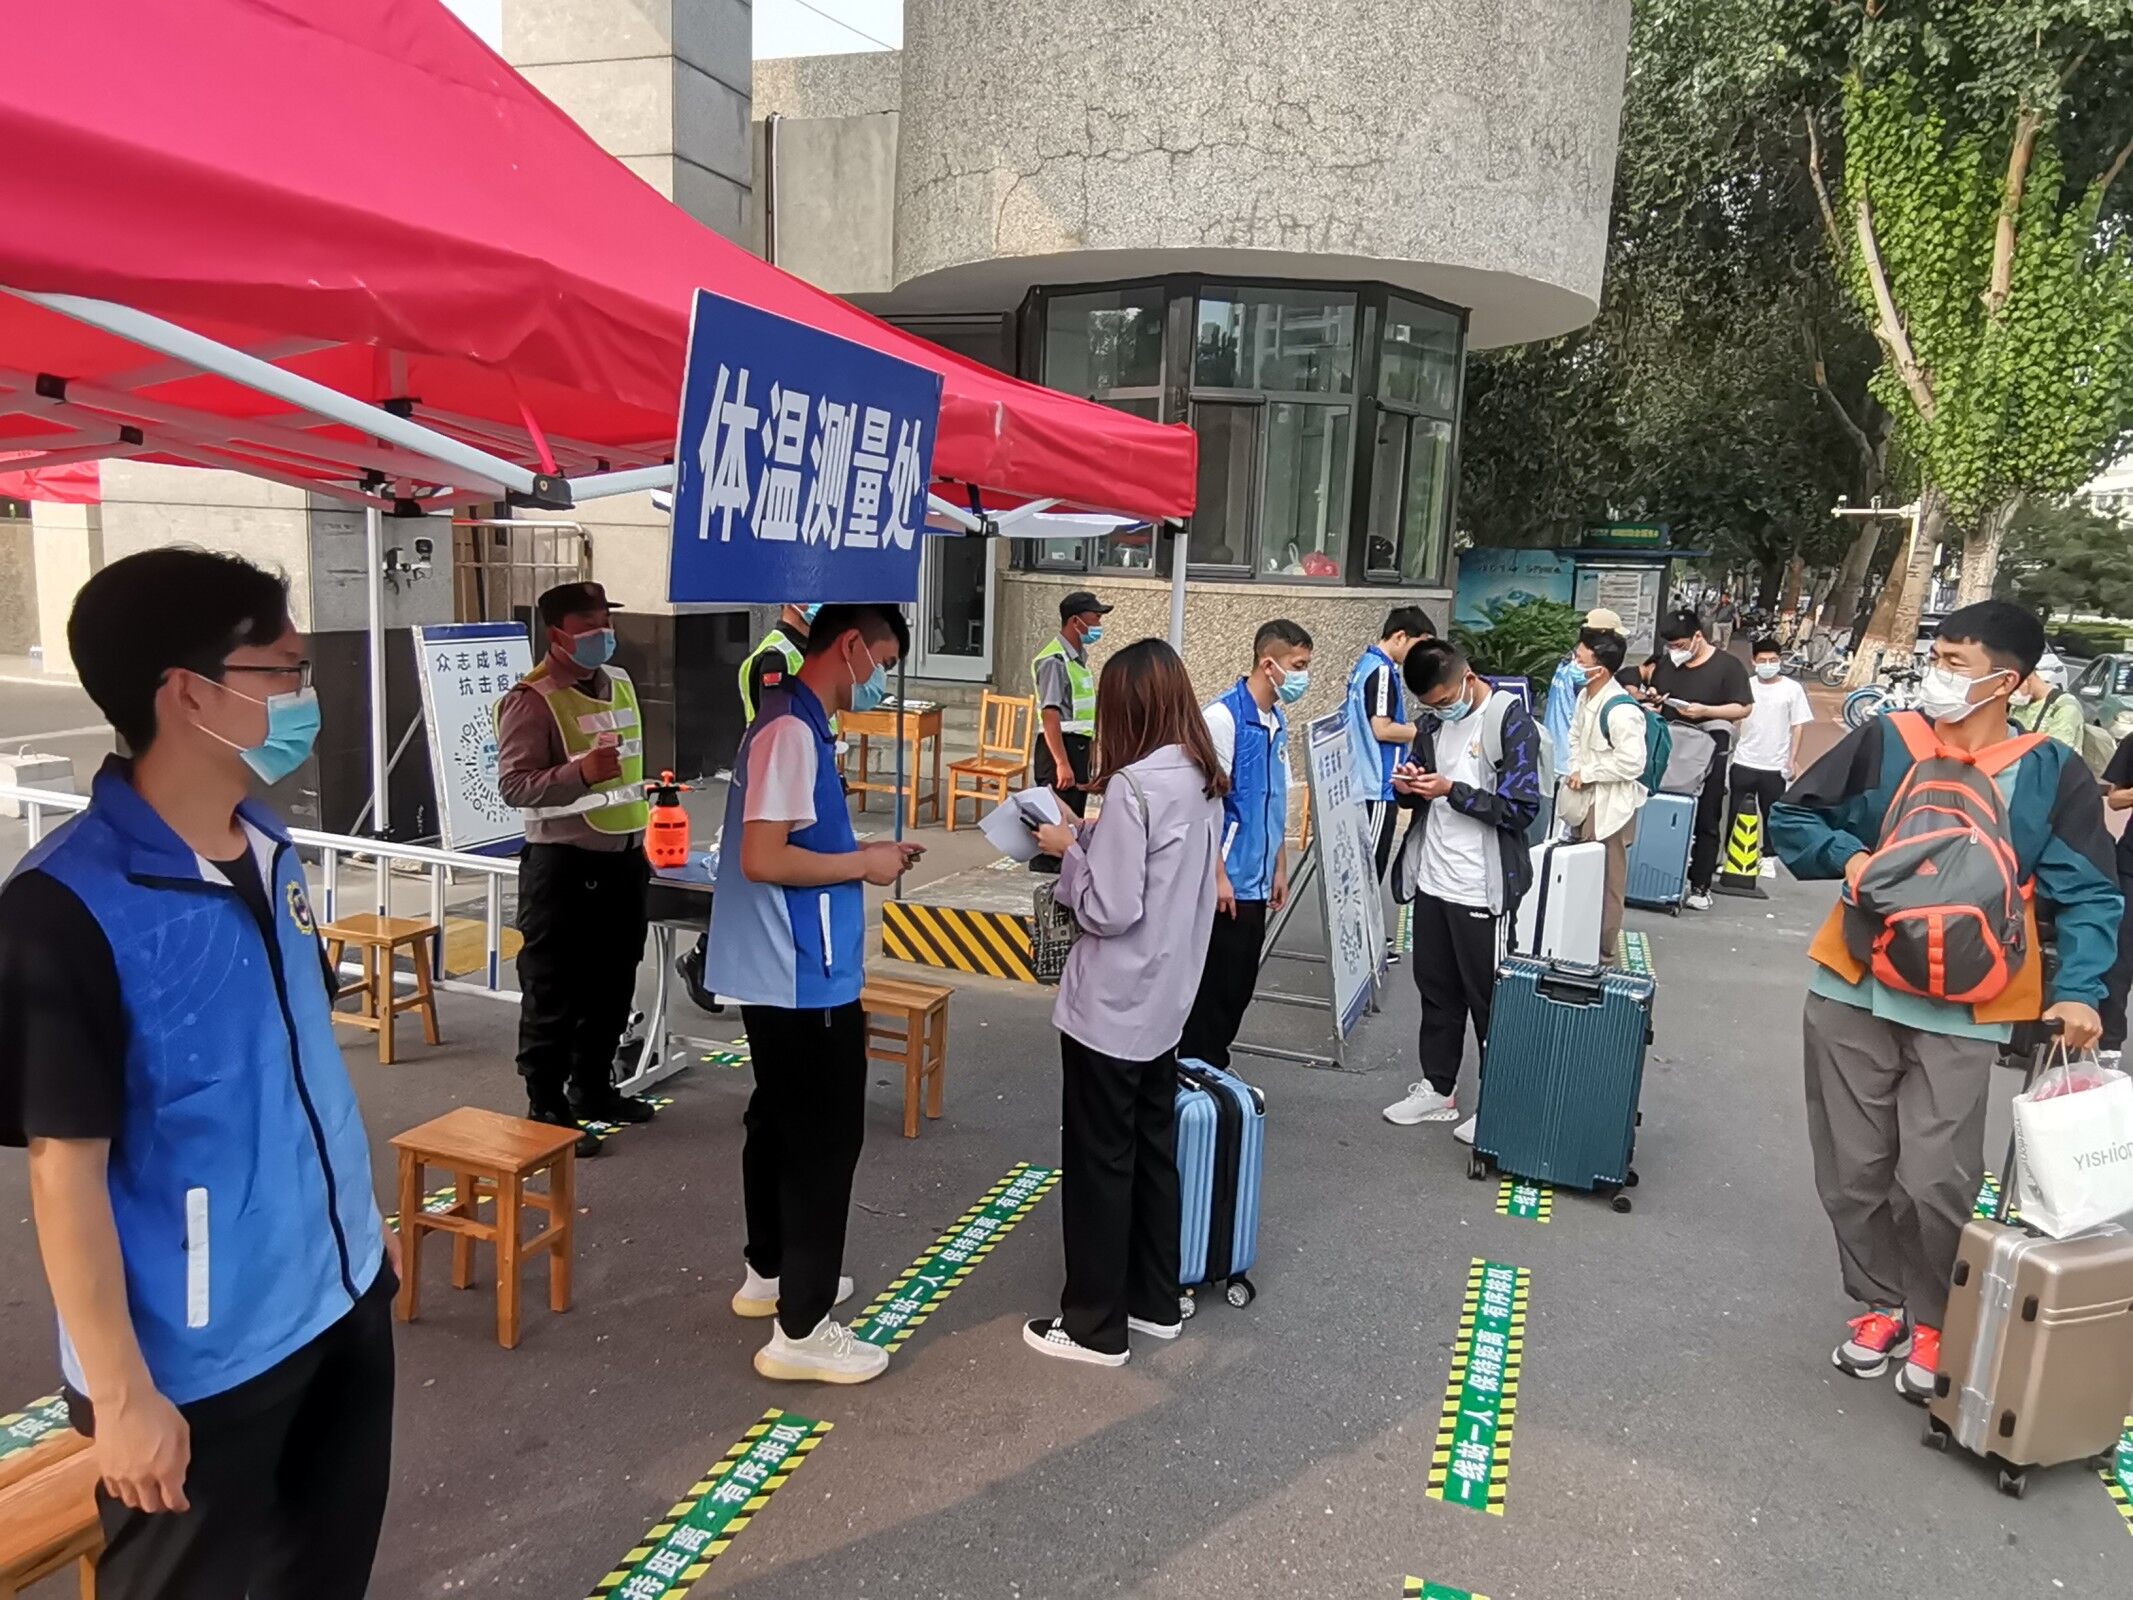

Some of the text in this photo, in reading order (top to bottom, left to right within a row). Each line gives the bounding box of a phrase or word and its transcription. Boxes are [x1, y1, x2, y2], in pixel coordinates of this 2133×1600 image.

[699, 363, 922, 550] 体温测量处
[436, 649, 508, 672] 众志成城
